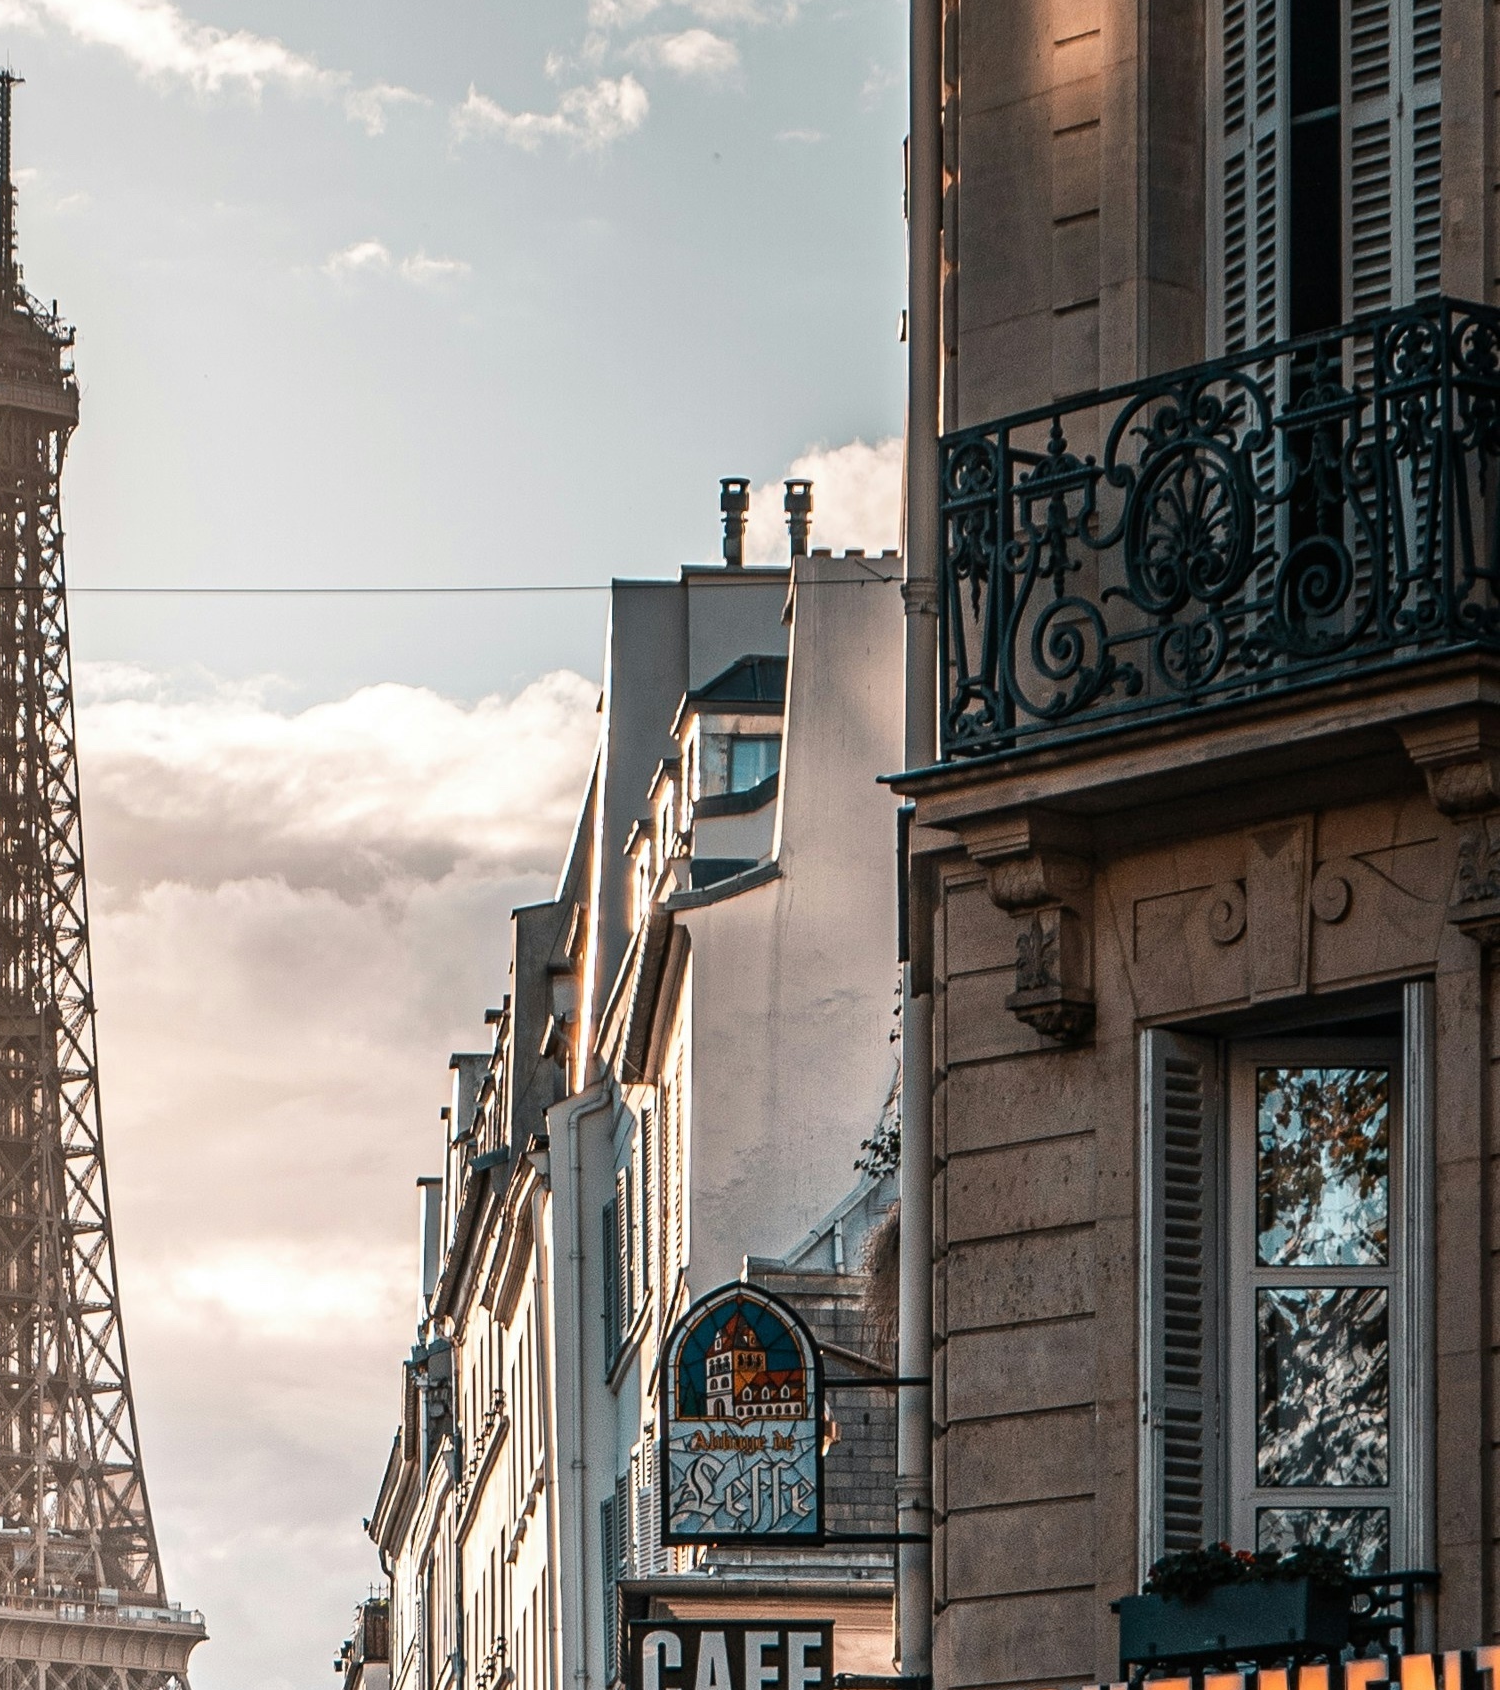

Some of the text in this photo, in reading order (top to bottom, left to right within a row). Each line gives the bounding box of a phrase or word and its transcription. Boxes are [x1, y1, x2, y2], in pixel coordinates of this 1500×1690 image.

[690, 1430, 795, 1455] Abbaye de
[674, 1453, 816, 1531] Leffe
